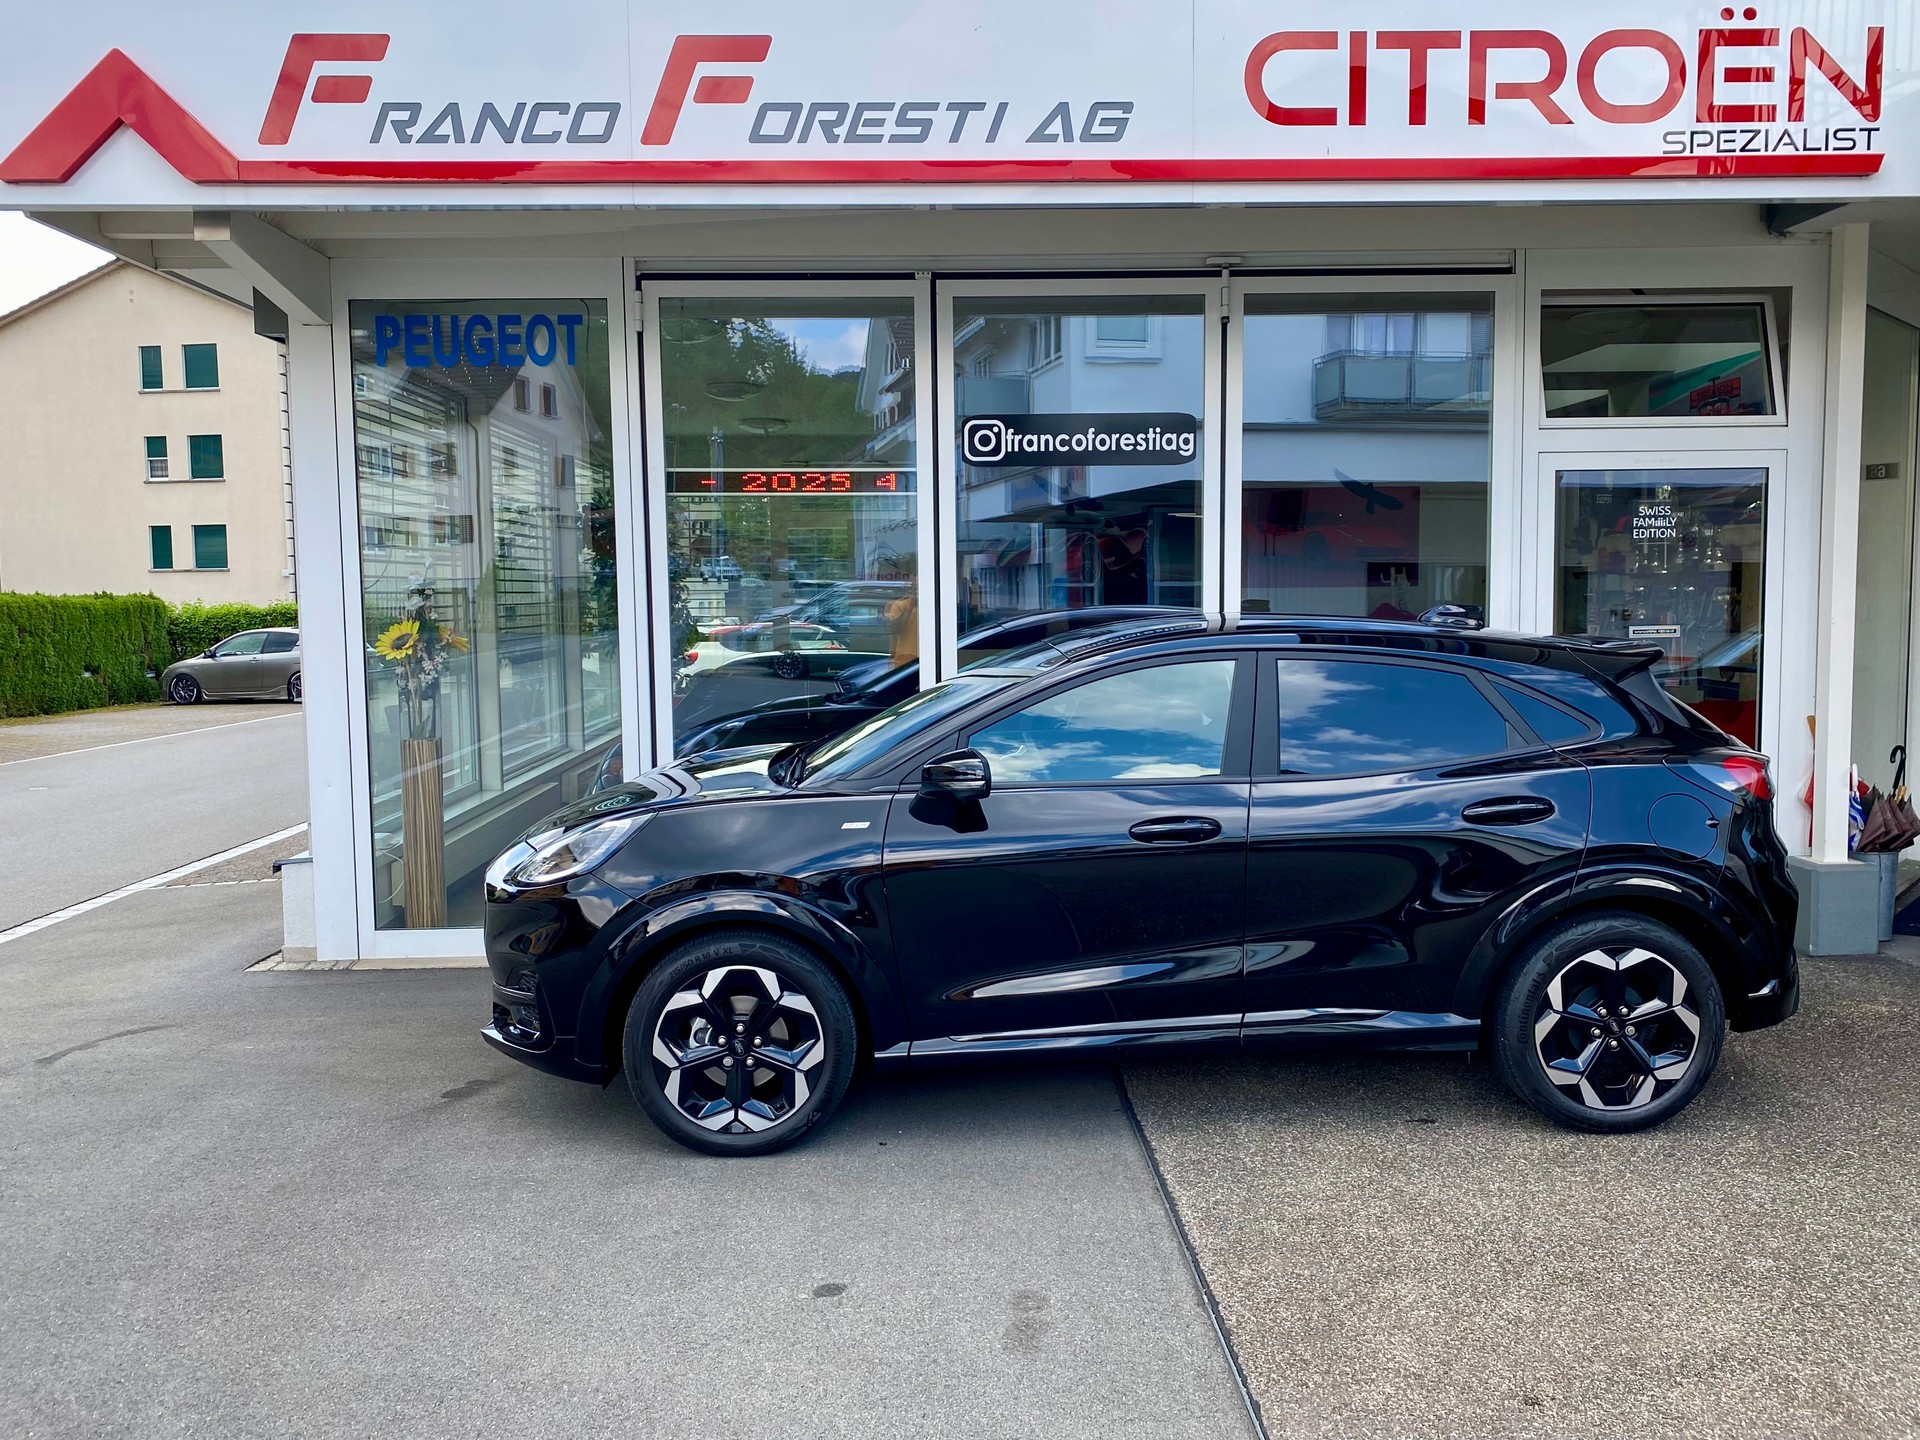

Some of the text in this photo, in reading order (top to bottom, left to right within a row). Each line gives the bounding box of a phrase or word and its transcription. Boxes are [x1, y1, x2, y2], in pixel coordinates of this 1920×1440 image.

[1244, 8, 1884, 126] CITROËN
[259, 34, 1134, 145] FRANCO FORESTI AG
[1662, 127, 1881, 155] SPEZIALIST
[375, 314, 583, 368] PEUGEOT
[1006, 427, 1195, 457] francoforestiag
[742, 473, 851, 491] 2025
[1638, 505, 1672, 516] SWISS
[1633, 528, 1676, 539] EDITION
[722, 947, 734, 955] XL
[1518, 979, 1541, 1043] Continental
